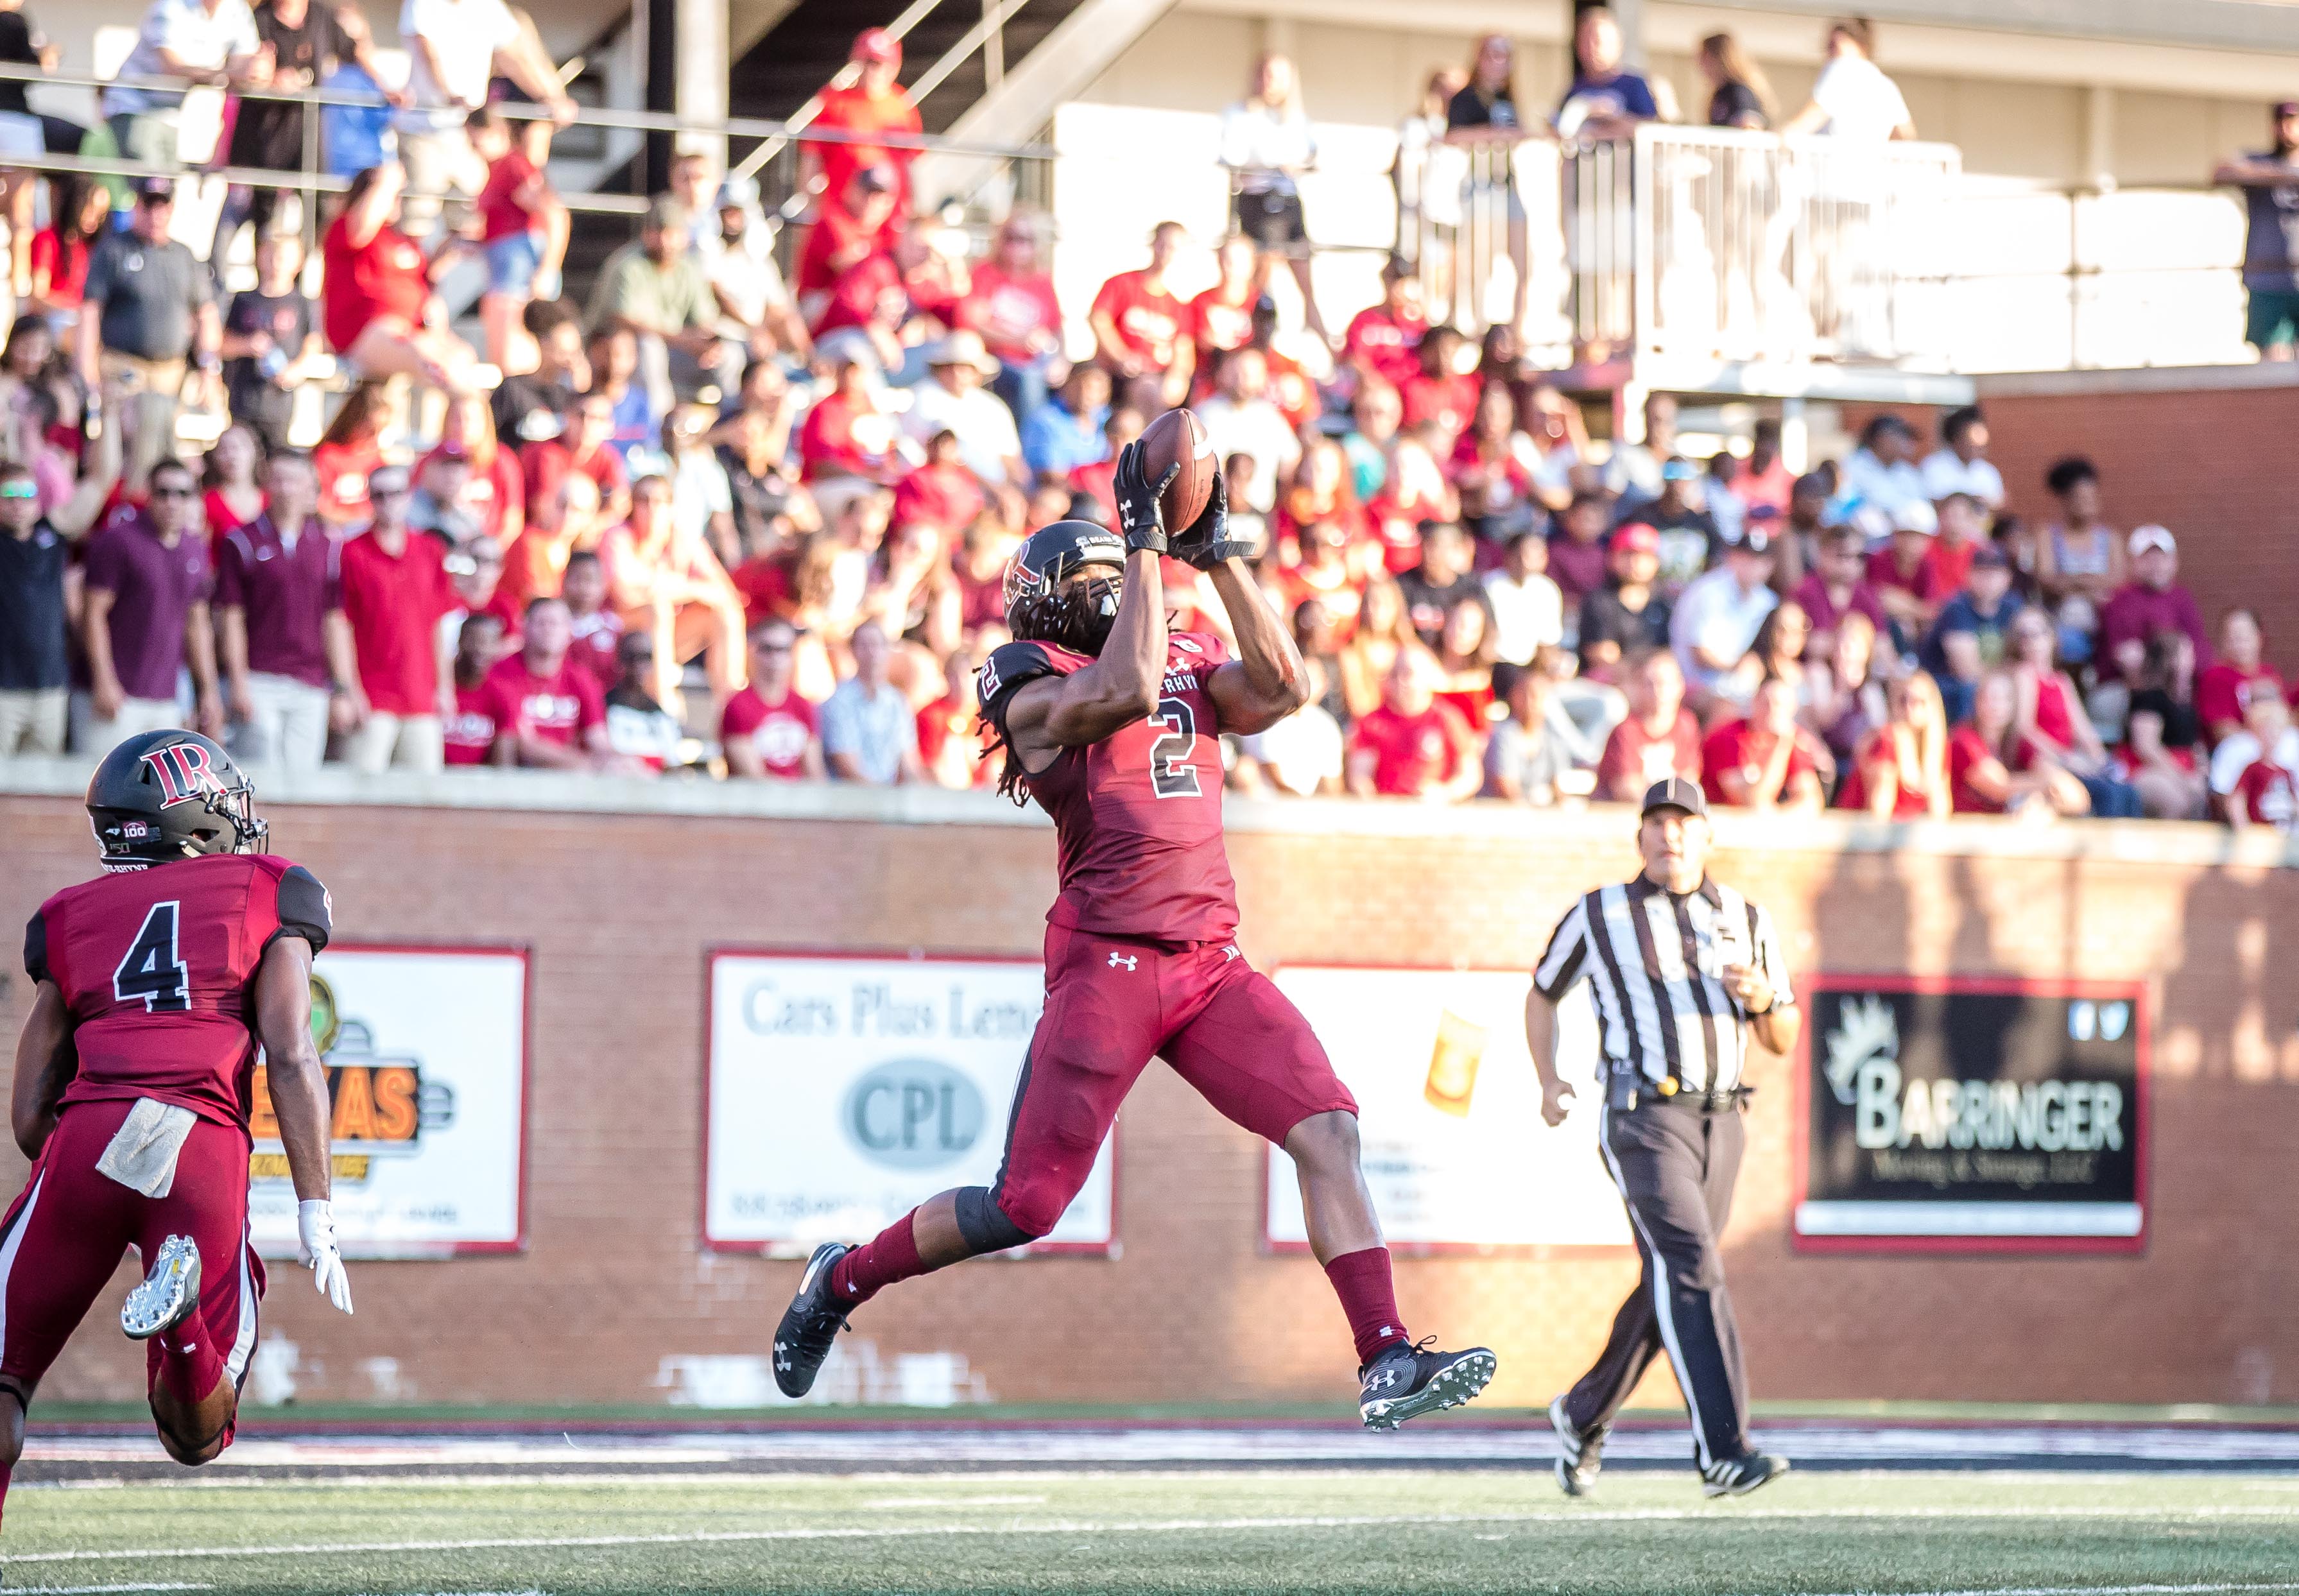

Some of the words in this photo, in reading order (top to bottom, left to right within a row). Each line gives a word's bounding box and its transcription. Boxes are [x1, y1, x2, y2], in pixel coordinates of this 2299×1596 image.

[979, 656, 1003, 701] 2
[1147, 696, 1203, 800] 2
[123, 827, 147, 838] 100
[112, 900, 192, 1013] 4
[742, 977, 838, 1037] Cars
[851, 981, 938, 1038] Plus
[852, 1074, 978, 1151] CPL
[1857, 1059, 2124, 1152] BARRINGER
